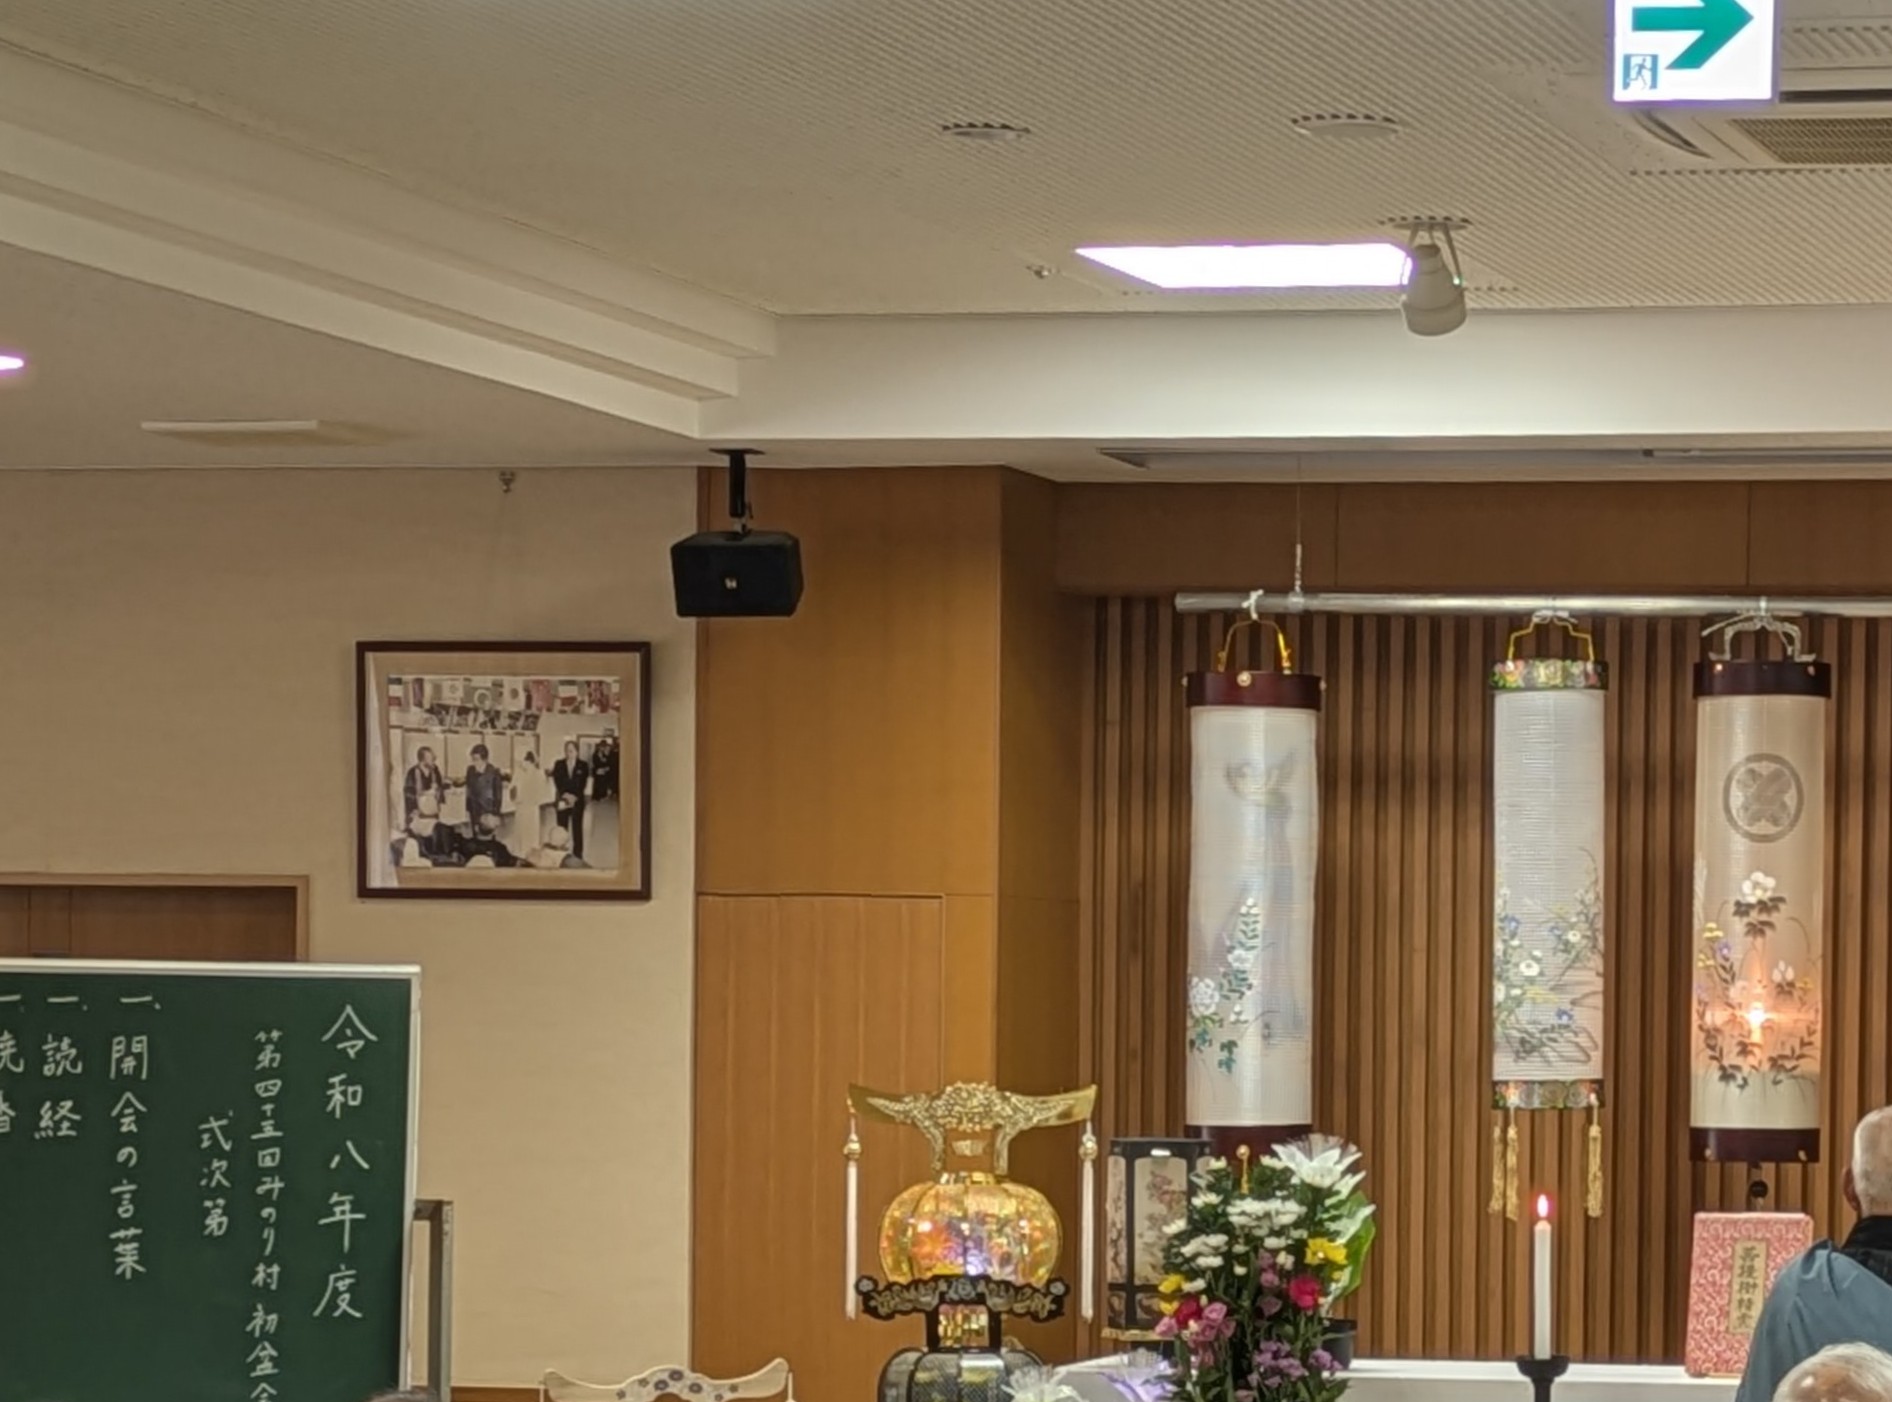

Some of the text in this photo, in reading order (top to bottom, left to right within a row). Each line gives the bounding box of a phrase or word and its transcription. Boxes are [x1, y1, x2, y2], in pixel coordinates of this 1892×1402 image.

[199, 1110, 233, 1237] 式次第
[312, 1004, 378, 1319] 令和八年度
